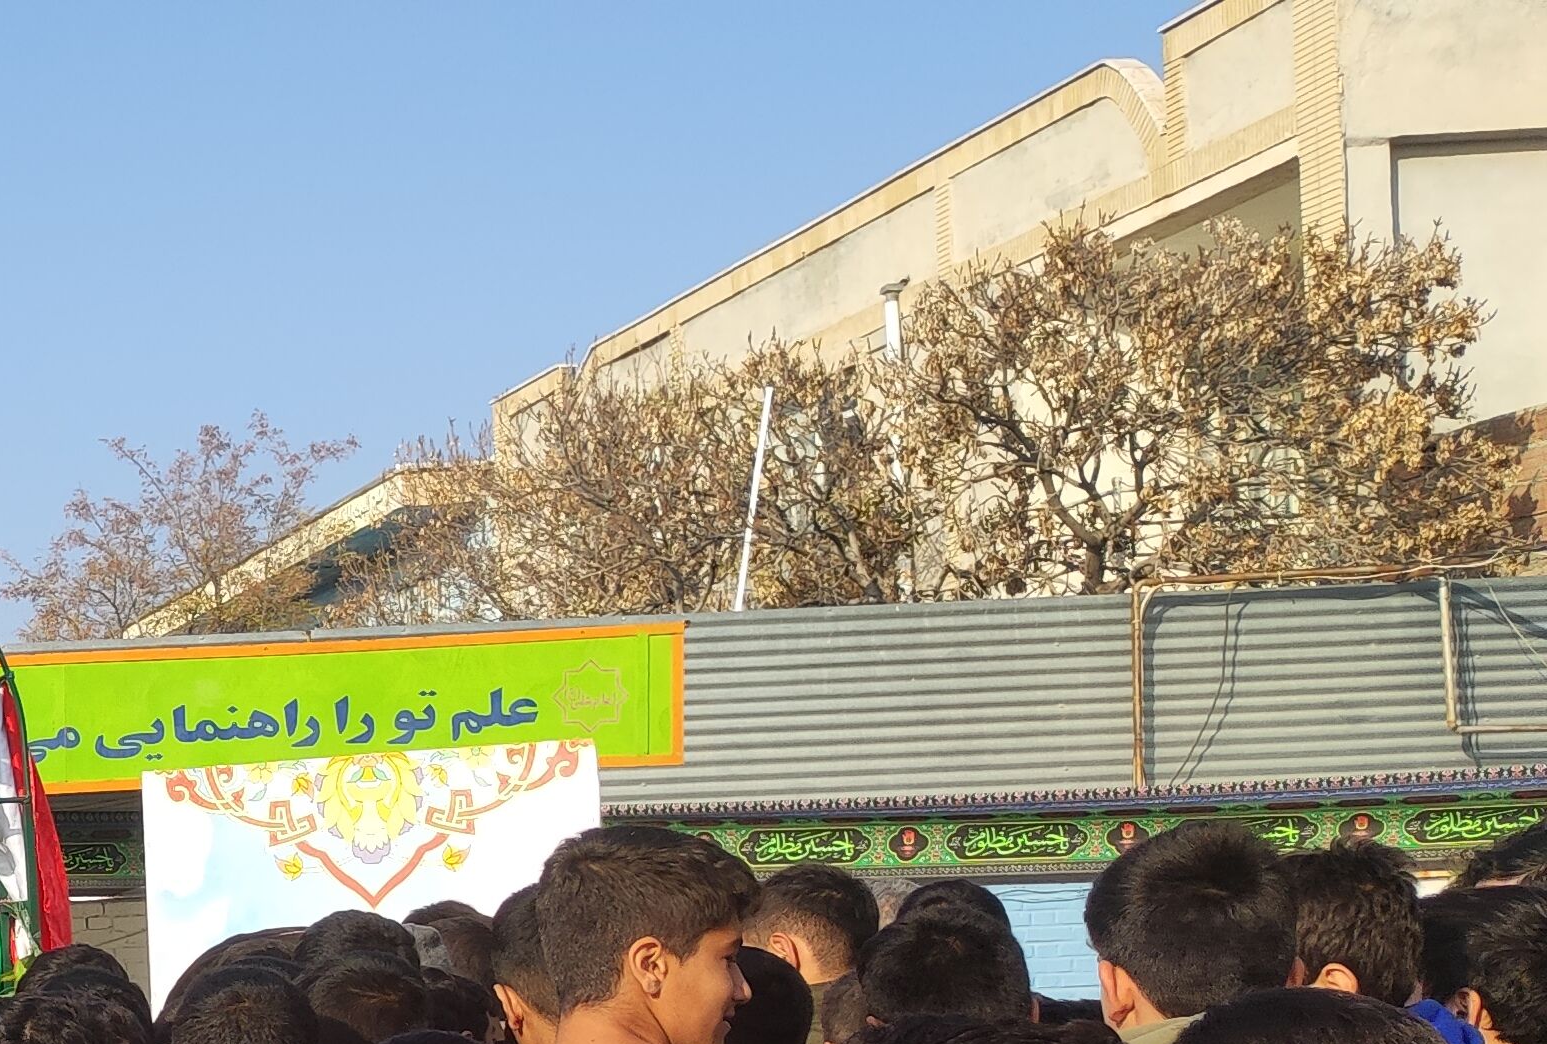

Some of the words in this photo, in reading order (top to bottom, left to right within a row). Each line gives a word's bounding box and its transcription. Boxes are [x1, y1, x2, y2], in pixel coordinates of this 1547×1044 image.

[94, 697, 322, 762] راهنمایی
[334, 695, 376, 745] را
[386, 689, 437, 746] تو
[451, 686, 539, 741] علم
